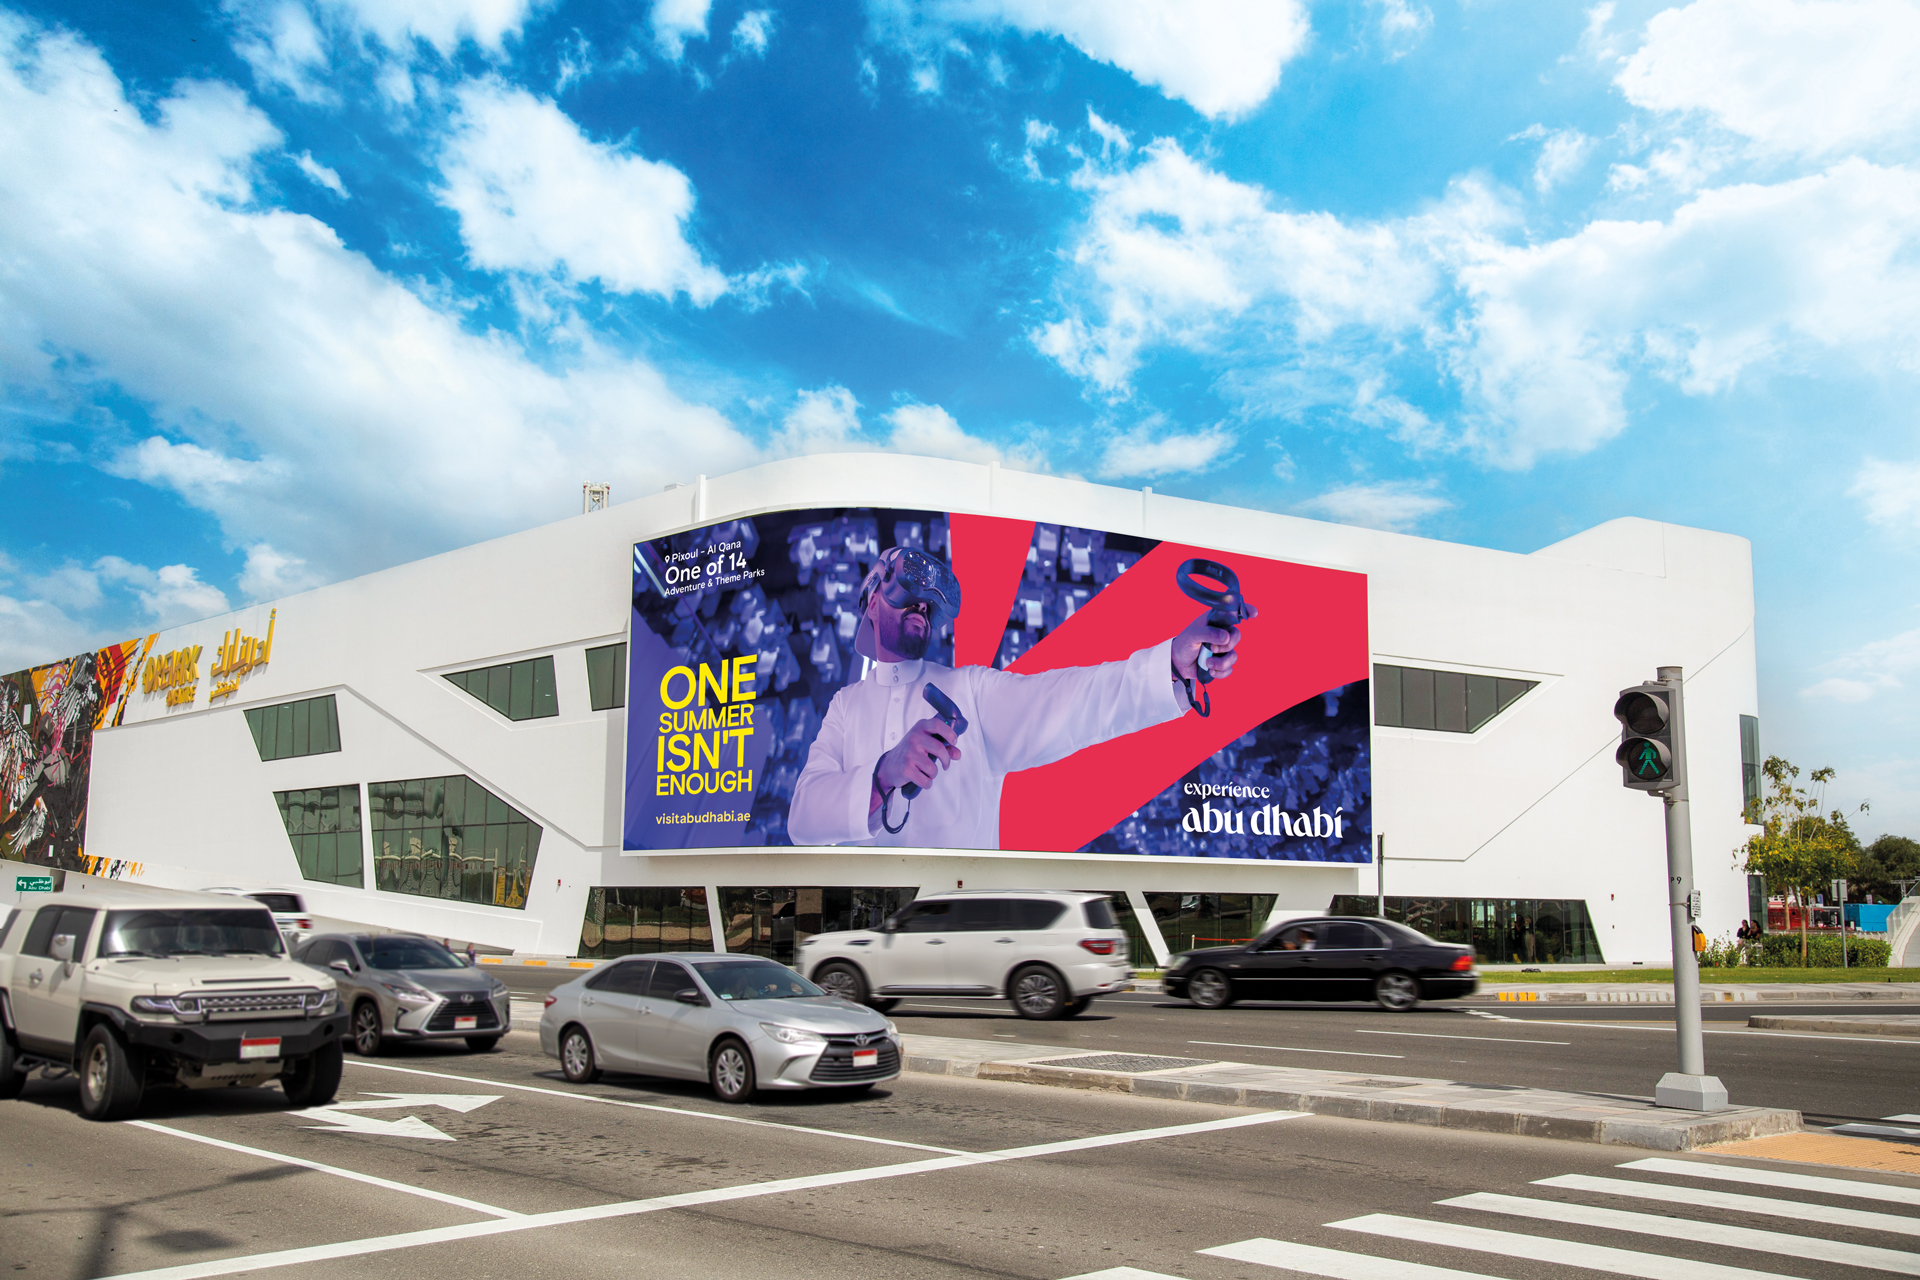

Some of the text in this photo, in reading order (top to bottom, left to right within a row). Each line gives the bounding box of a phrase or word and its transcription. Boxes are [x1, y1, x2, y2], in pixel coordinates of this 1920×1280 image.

[665, 551, 747, 584] One of 14
[671, 548, 699, 563] Pixoul
[707, 544, 717, 555] Al
[718, 541, 741, 552] Qana
[664, 568, 765, 596] Adventure & Theme Parks
[660, 654, 757, 710] ONE
[658, 703, 755, 734] SUMMER
[657, 727, 755, 773] ISN'T
[656, 769, 753, 796] ENOUGH
[655, 810, 751, 824] visitabudhabi.ae
[1182, 801, 1245, 834] abu
